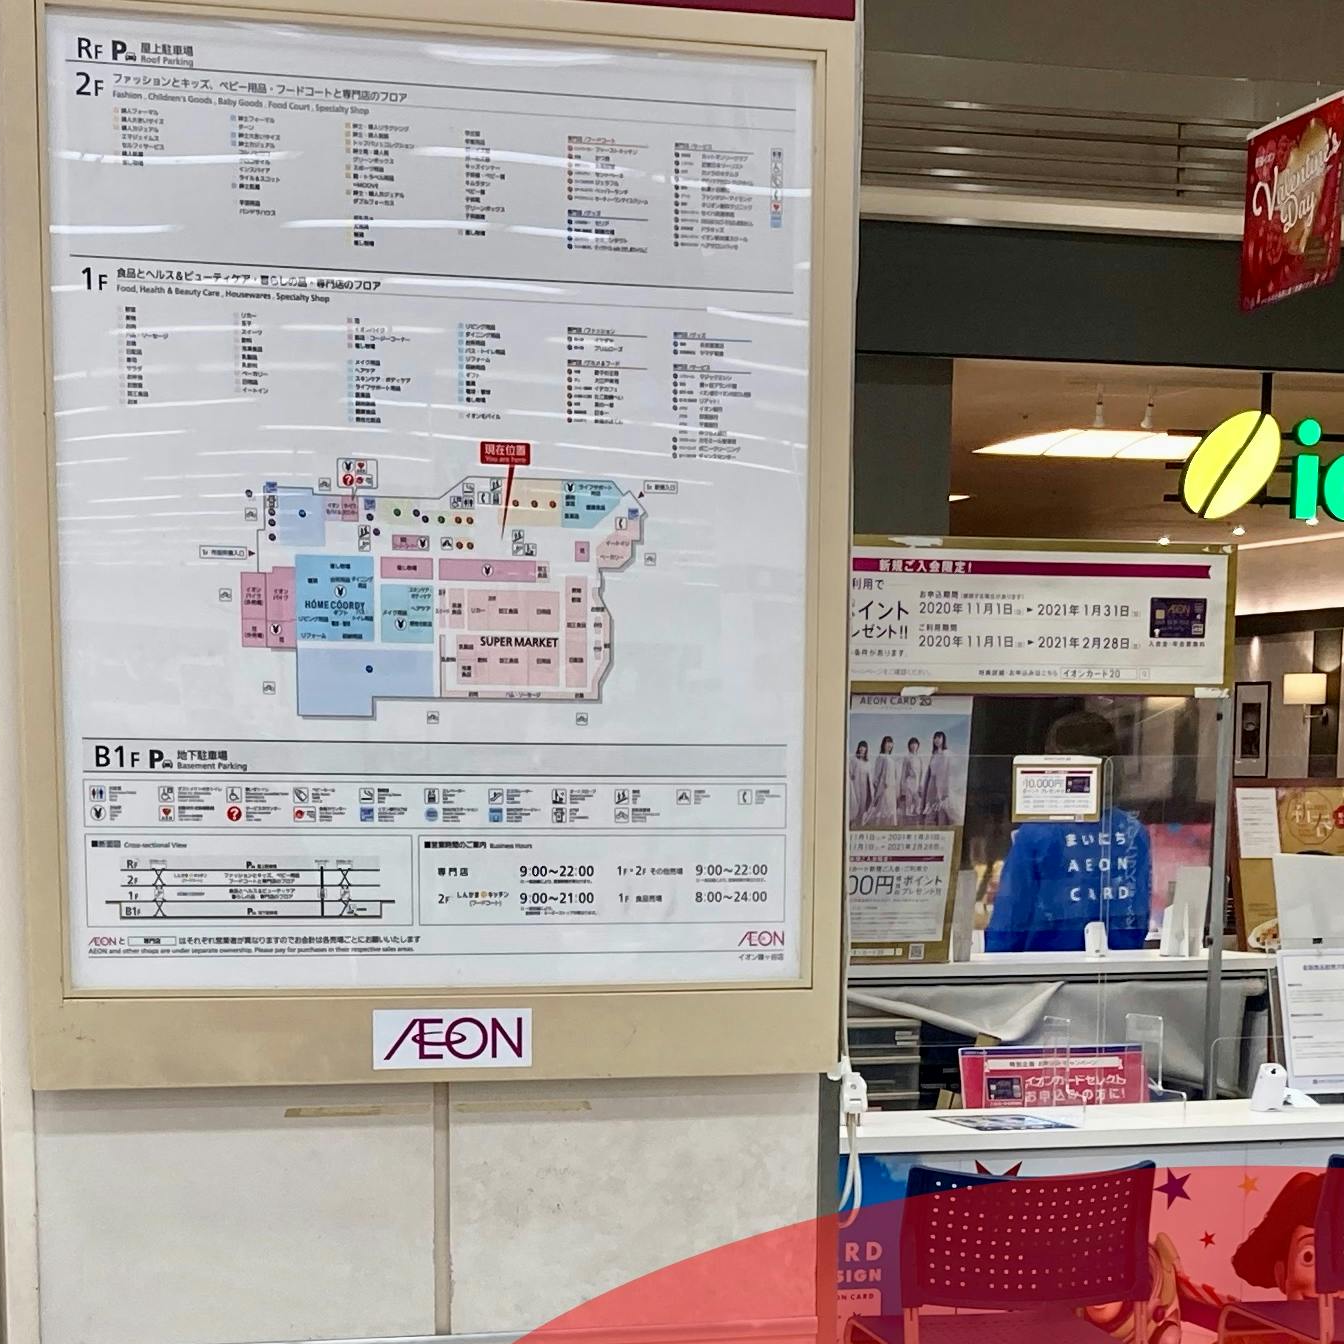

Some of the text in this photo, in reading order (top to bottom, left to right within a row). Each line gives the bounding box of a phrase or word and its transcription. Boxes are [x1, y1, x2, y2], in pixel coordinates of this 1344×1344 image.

[141, 42, 194, 57] 屋上駐車場
[141, 55, 194, 68] Roof Parking
[75, 72, 104, 97] 2F
[113, 90, 142, 99] Fashion
[188, 96, 212, 105] Goods
[218, 97, 236, 107] Baby
[238, 99, 263, 108] Goods
[268, 101, 287, 110] Food
[289, 102, 311, 111] Court
[315, 104, 349, 115] Specialty
[350, 106, 370, 116] Shop
[1252, 127, 1341, 220] Valentine's
[1280, 191, 1316, 234] Day
[81, 267, 107, 291] 1F
[117, 284, 138, 295] Food,
[140, 286, 164, 295] Health
[175, 287, 200, 298] Beauty
[202, 288, 220, 297] Care
[225, 290, 272, 300] Housewares
[276, 292, 309, 303] Specialty
[311, 294, 330, 303] Shop
[484, 444, 526, 456] 現在位置
[879, 559, 973, 573] 新規ご入会限定!
[919, 590, 959, 599] お申込期間
[852, 600, 910, 622] イント
[918, 624, 958, 632] ご利用期間
[480, 636, 559, 648] SUPER MARKET
[859, 696, 887, 706] AEON
[890, 696, 917, 706] CARD
[95, 745, 140, 768] B1F
[177, 750, 228, 761] 地下駐車場
[177, 762, 247, 772] Basement Parking
[1065, 832, 1126, 847] まいにち
[1068, 858, 1128, 873] AEON
[384, 1017, 522, 1060] AEON
